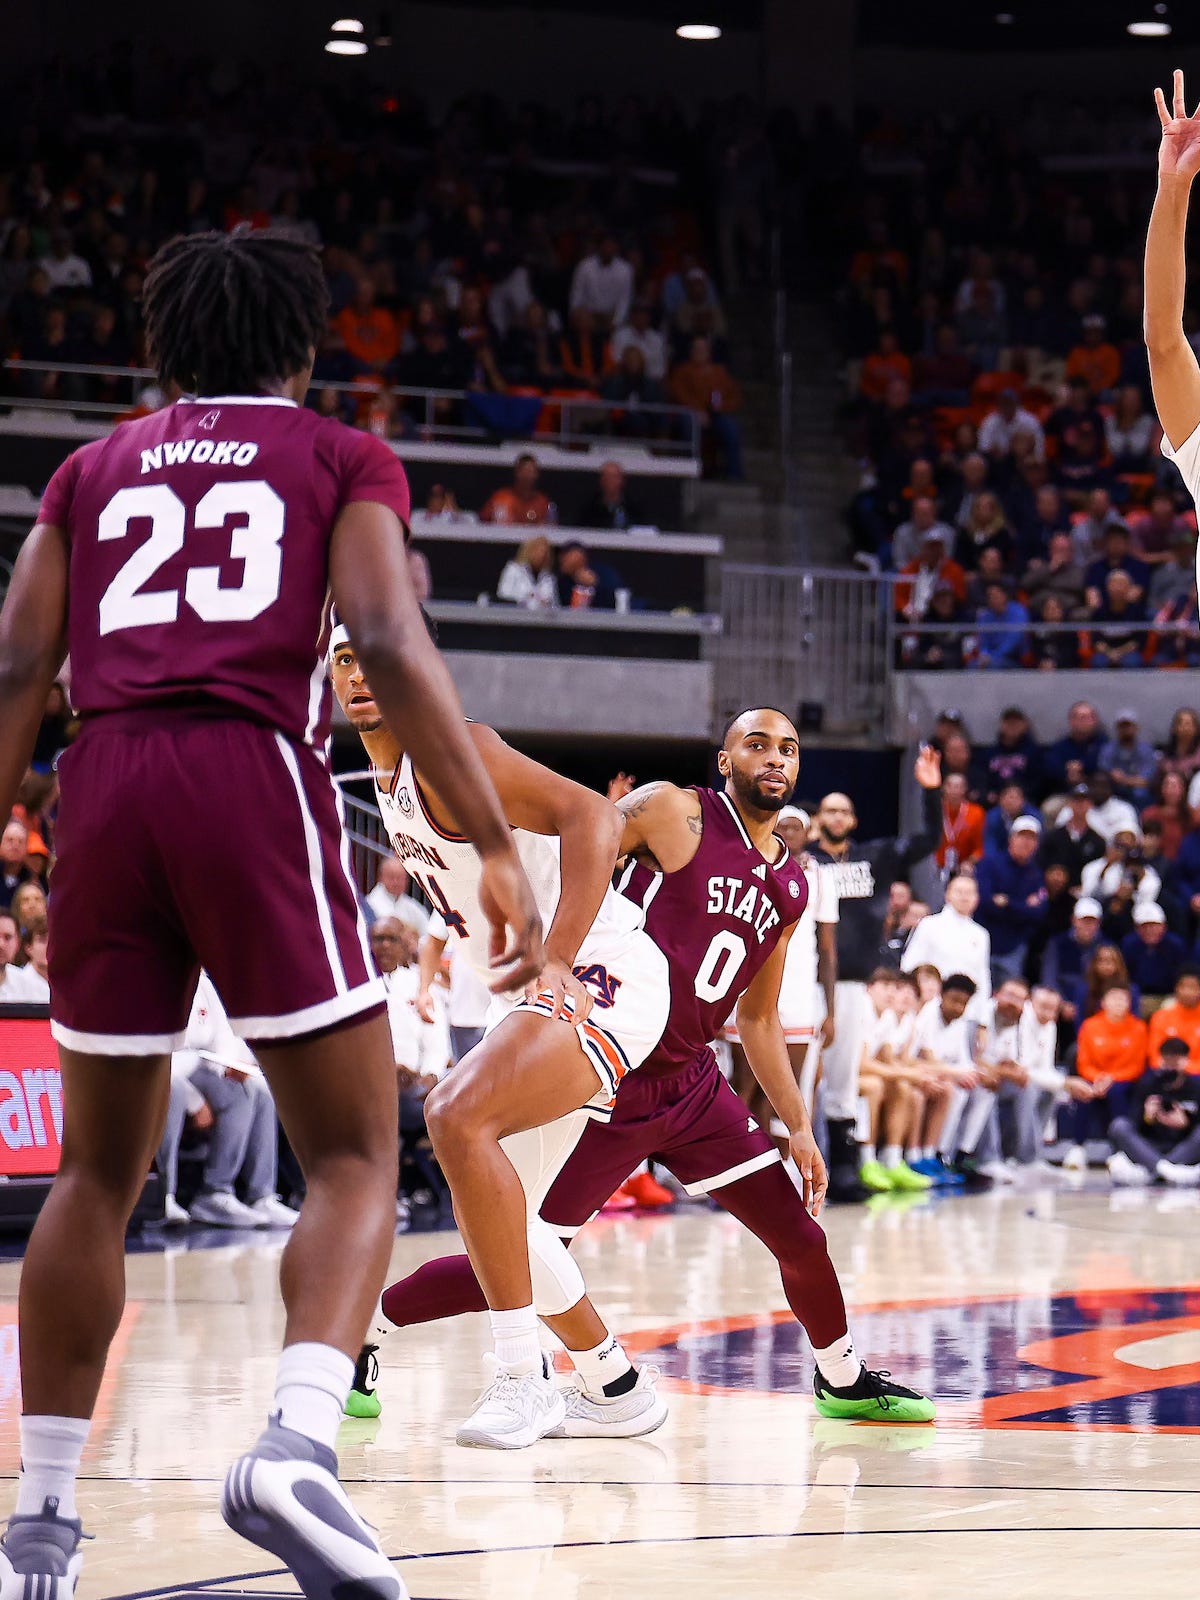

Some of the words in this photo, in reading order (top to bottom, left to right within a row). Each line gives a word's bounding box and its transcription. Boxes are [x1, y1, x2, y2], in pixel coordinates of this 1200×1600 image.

[140, 438, 259, 475] NWOKO
[97, 479, 286, 637] 23
[391, 832, 451, 871] UBURN
[706, 876, 781, 945] STATE
[693, 929, 748, 1004] 0
